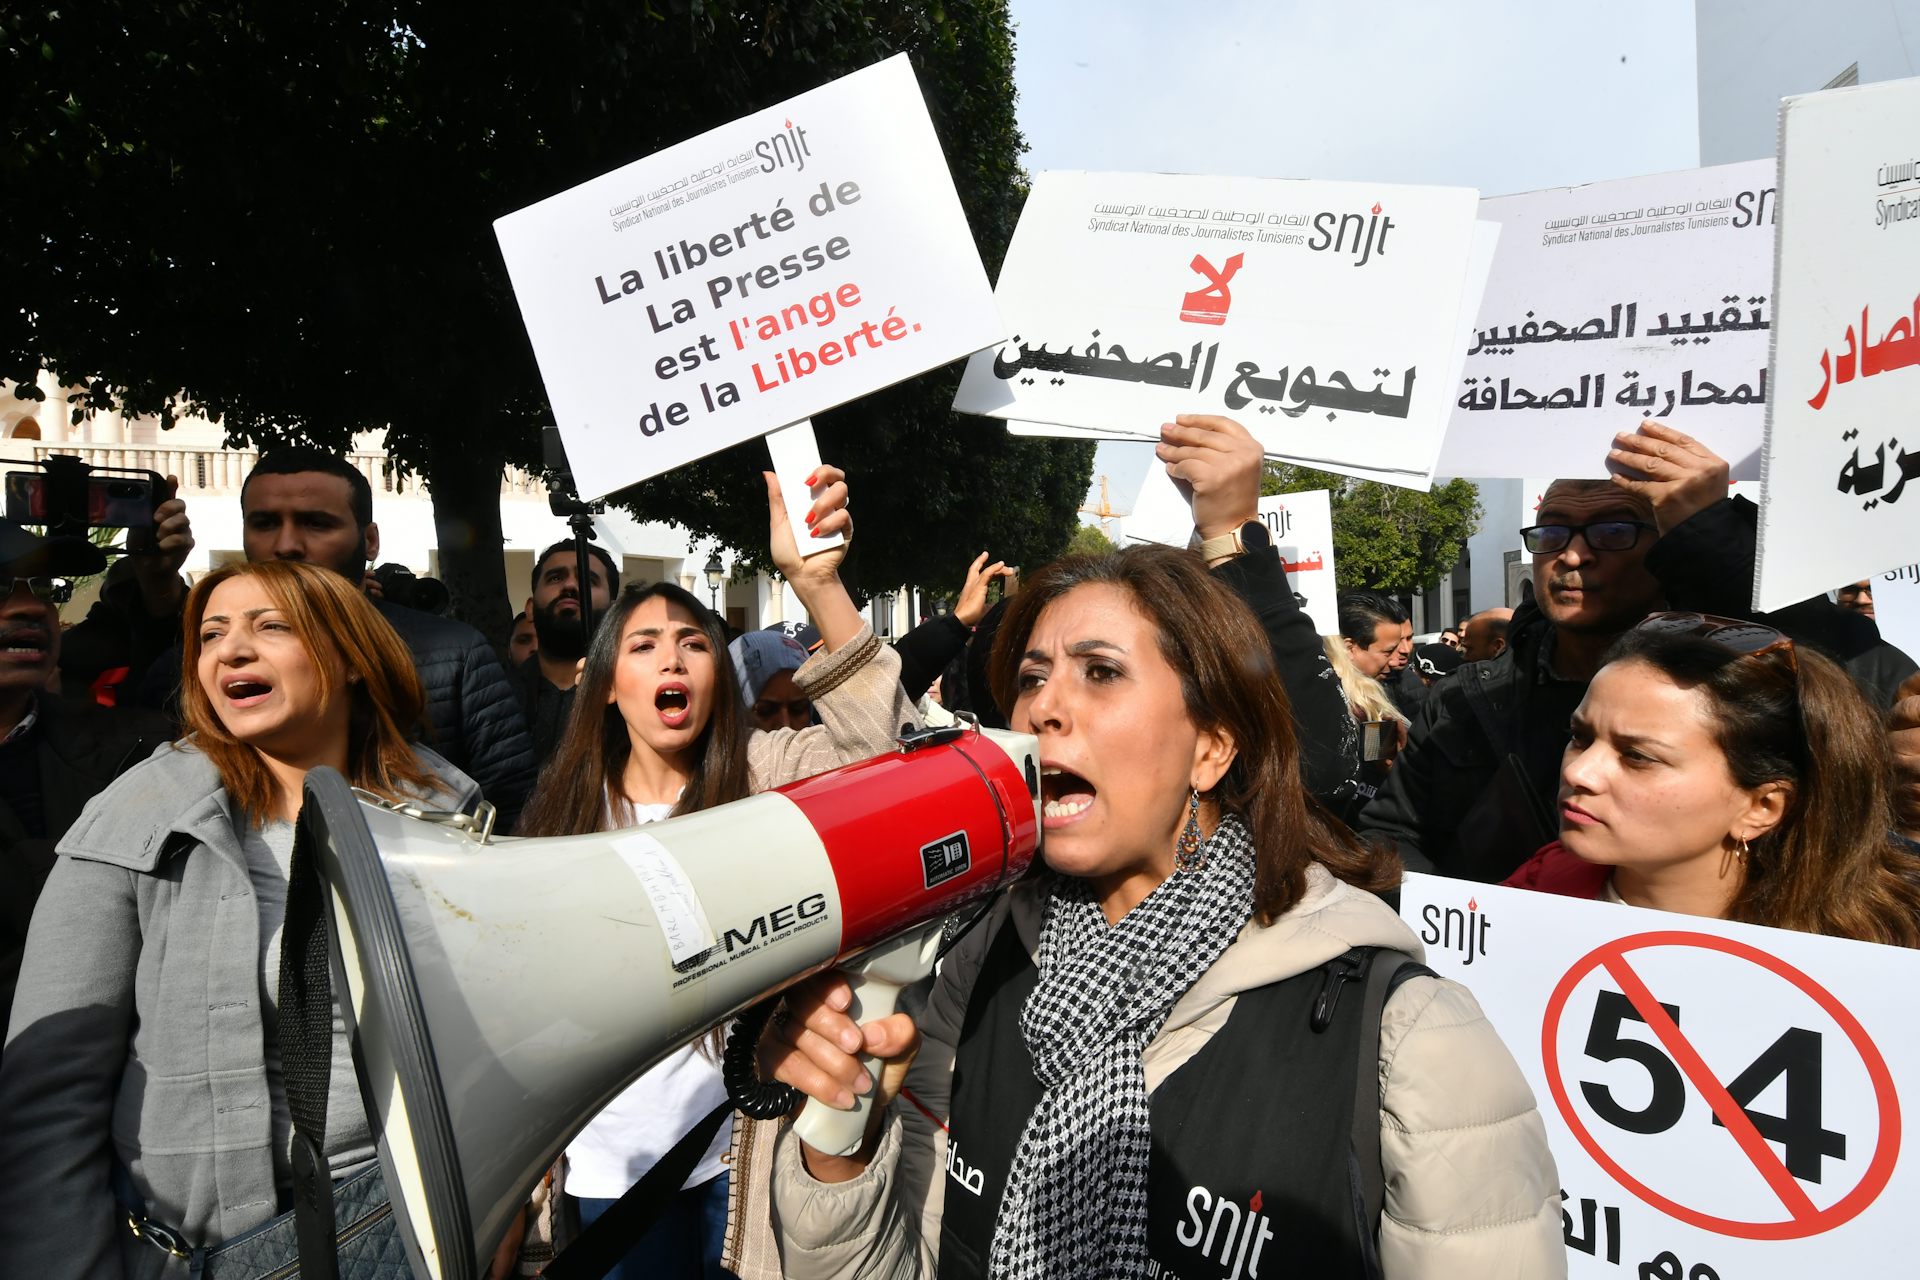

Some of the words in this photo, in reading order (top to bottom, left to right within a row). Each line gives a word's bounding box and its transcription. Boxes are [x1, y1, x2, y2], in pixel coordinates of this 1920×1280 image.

[755, 117, 811, 173] snjt
[612, 212, 643, 233] Syndicat
[643, 199, 672, 220] National
[672, 195, 685, 211] des
[685, 178, 727, 203] Journalistes
[726, 165, 760, 187] Tunisiens
[1088, 217, 1129, 234] Syndicat
[1130, 220, 1170, 236] National
[1171, 223, 1190, 238] des
[1190, 224, 1253, 242] Journalistes
[1255, 228, 1305, 246] Tunisiens
[1542, 233, 1577, 248] Syndicat
[1578, 229, 1613, 243] National
[1614, 226, 1629, 238] des
[1630, 220, 1685, 236] Journalistes
[1687, 215, 1729, 230] Tunisiens
[1732, 187, 1776, 229] sn
[1876, 195, 1920, 230] Syndica
[594, 270, 645, 304] La
[653, 198, 796, 280] liberté
[808, 180, 862, 218] de
[1308, 201, 1396, 267] snjt
[645, 298, 697, 333] La
[706, 235, 852, 309] Presse
[1179, 252, 1244, 326] لا
[653, 334, 720, 380] est
[729, 282, 862, 352] l'ange
[1646, 295, 1770, 346] تقييد
[638, 401, 690, 437] de
[700, 378, 741, 414] la
[750, 306, 923, 393] Liberté.
[993, 328, 1219, 394] الصحفيين
[1224, 361, 1417, 423] لتجويع
[1457, 373, 1605, 412] الصحافة
[672, 958, 728, 989] PROFESSIONAL
[729, 944, 761, 962] MUSICAL
[763, 939, 769, 947] &
[770, 930, 792, 944] AUDIO
[793, 913, 829, 933] PRODUCTS
[1421, 896, 1491, 965] snjt
[1579, 989, 1846, 1185] 54
[1176, 1186, 1274, 1280] snjt
